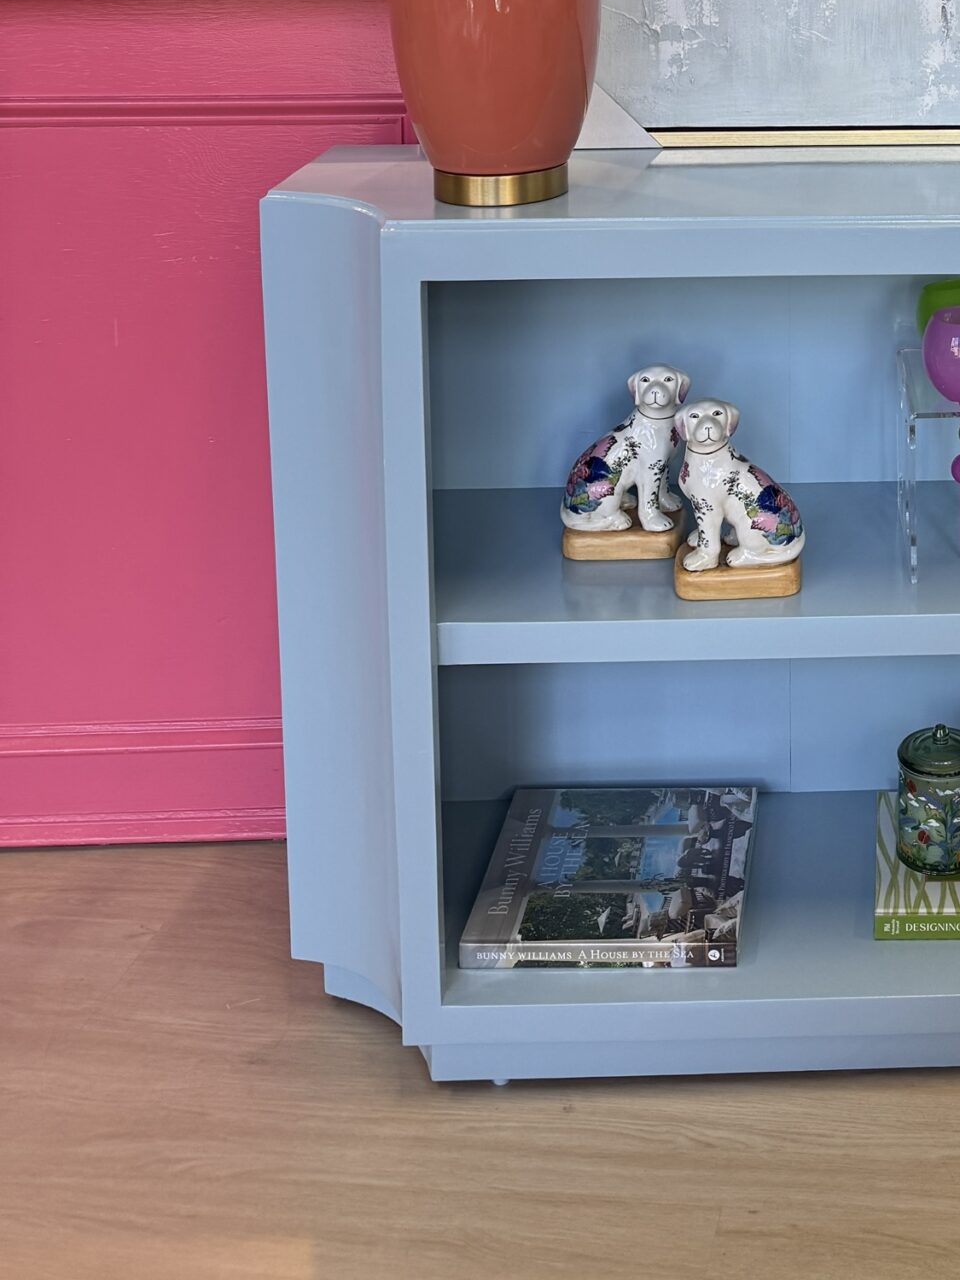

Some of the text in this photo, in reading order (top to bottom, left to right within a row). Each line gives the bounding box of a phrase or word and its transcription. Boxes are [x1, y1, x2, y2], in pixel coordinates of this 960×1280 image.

[487, 807, 543, 915] Bunny Williams
[540, 832, 570, 877] HOUSE
[553, 822, 591, 899] BY THE SEA
[476, 948, 694, 961] BUNNY WILLIAMS A HOUSE BY THE SEA
